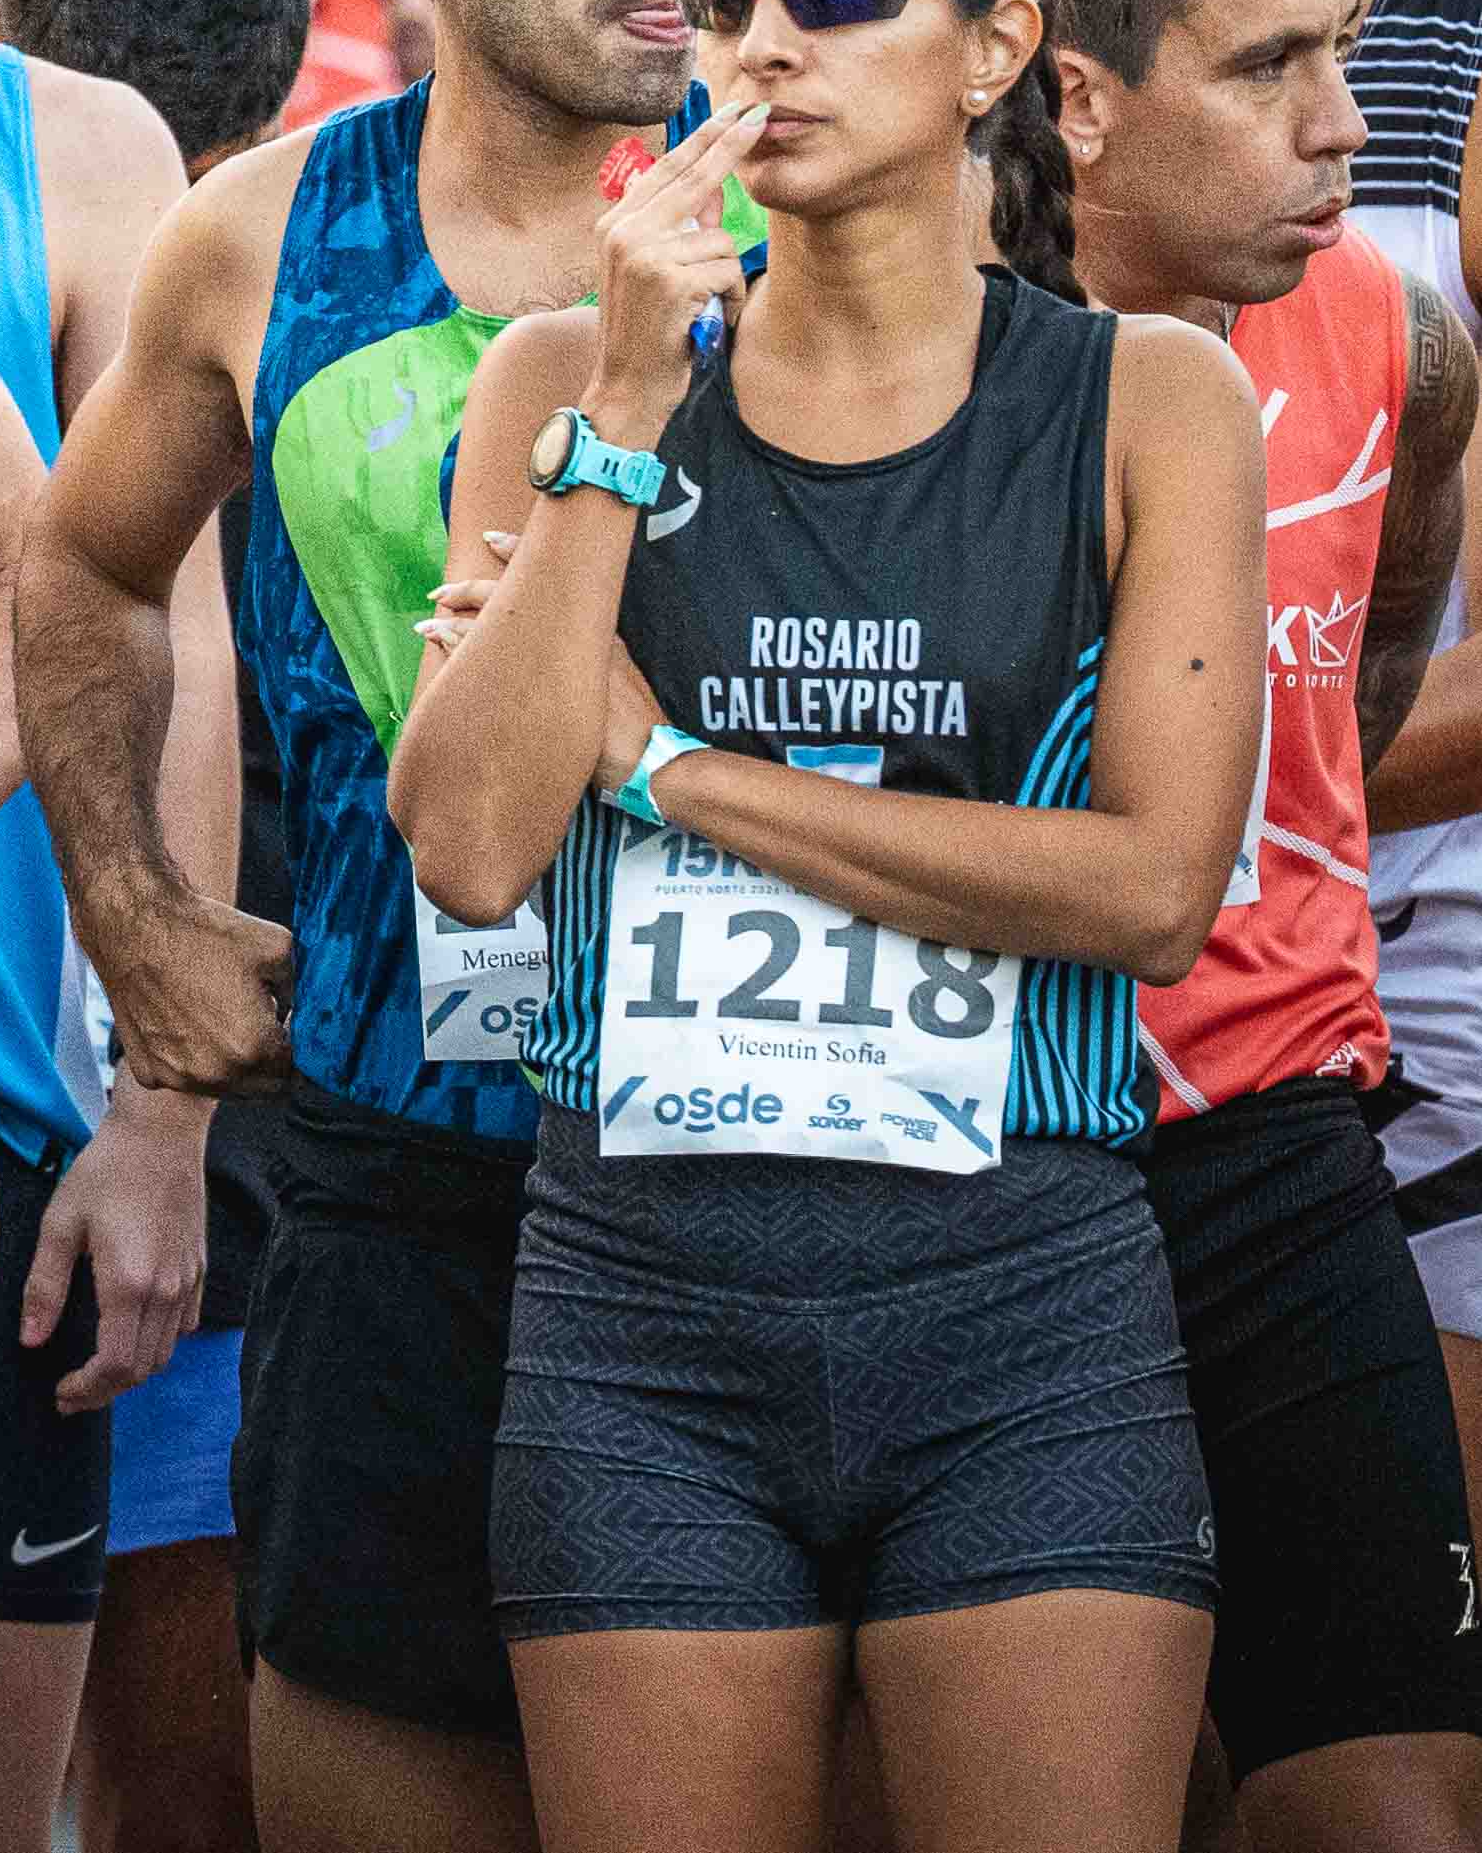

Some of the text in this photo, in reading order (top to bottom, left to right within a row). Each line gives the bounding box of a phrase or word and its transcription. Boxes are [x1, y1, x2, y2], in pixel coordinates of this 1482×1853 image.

[750, 616, 922, 671] ROSARIO
[700, 676, 968, 738] CALLEYPISTA
[623, 909, 996, 1040] 1218
[718, 1034, 818, 1062] Vicentin
[654, 1082, 784, 1132] osde
